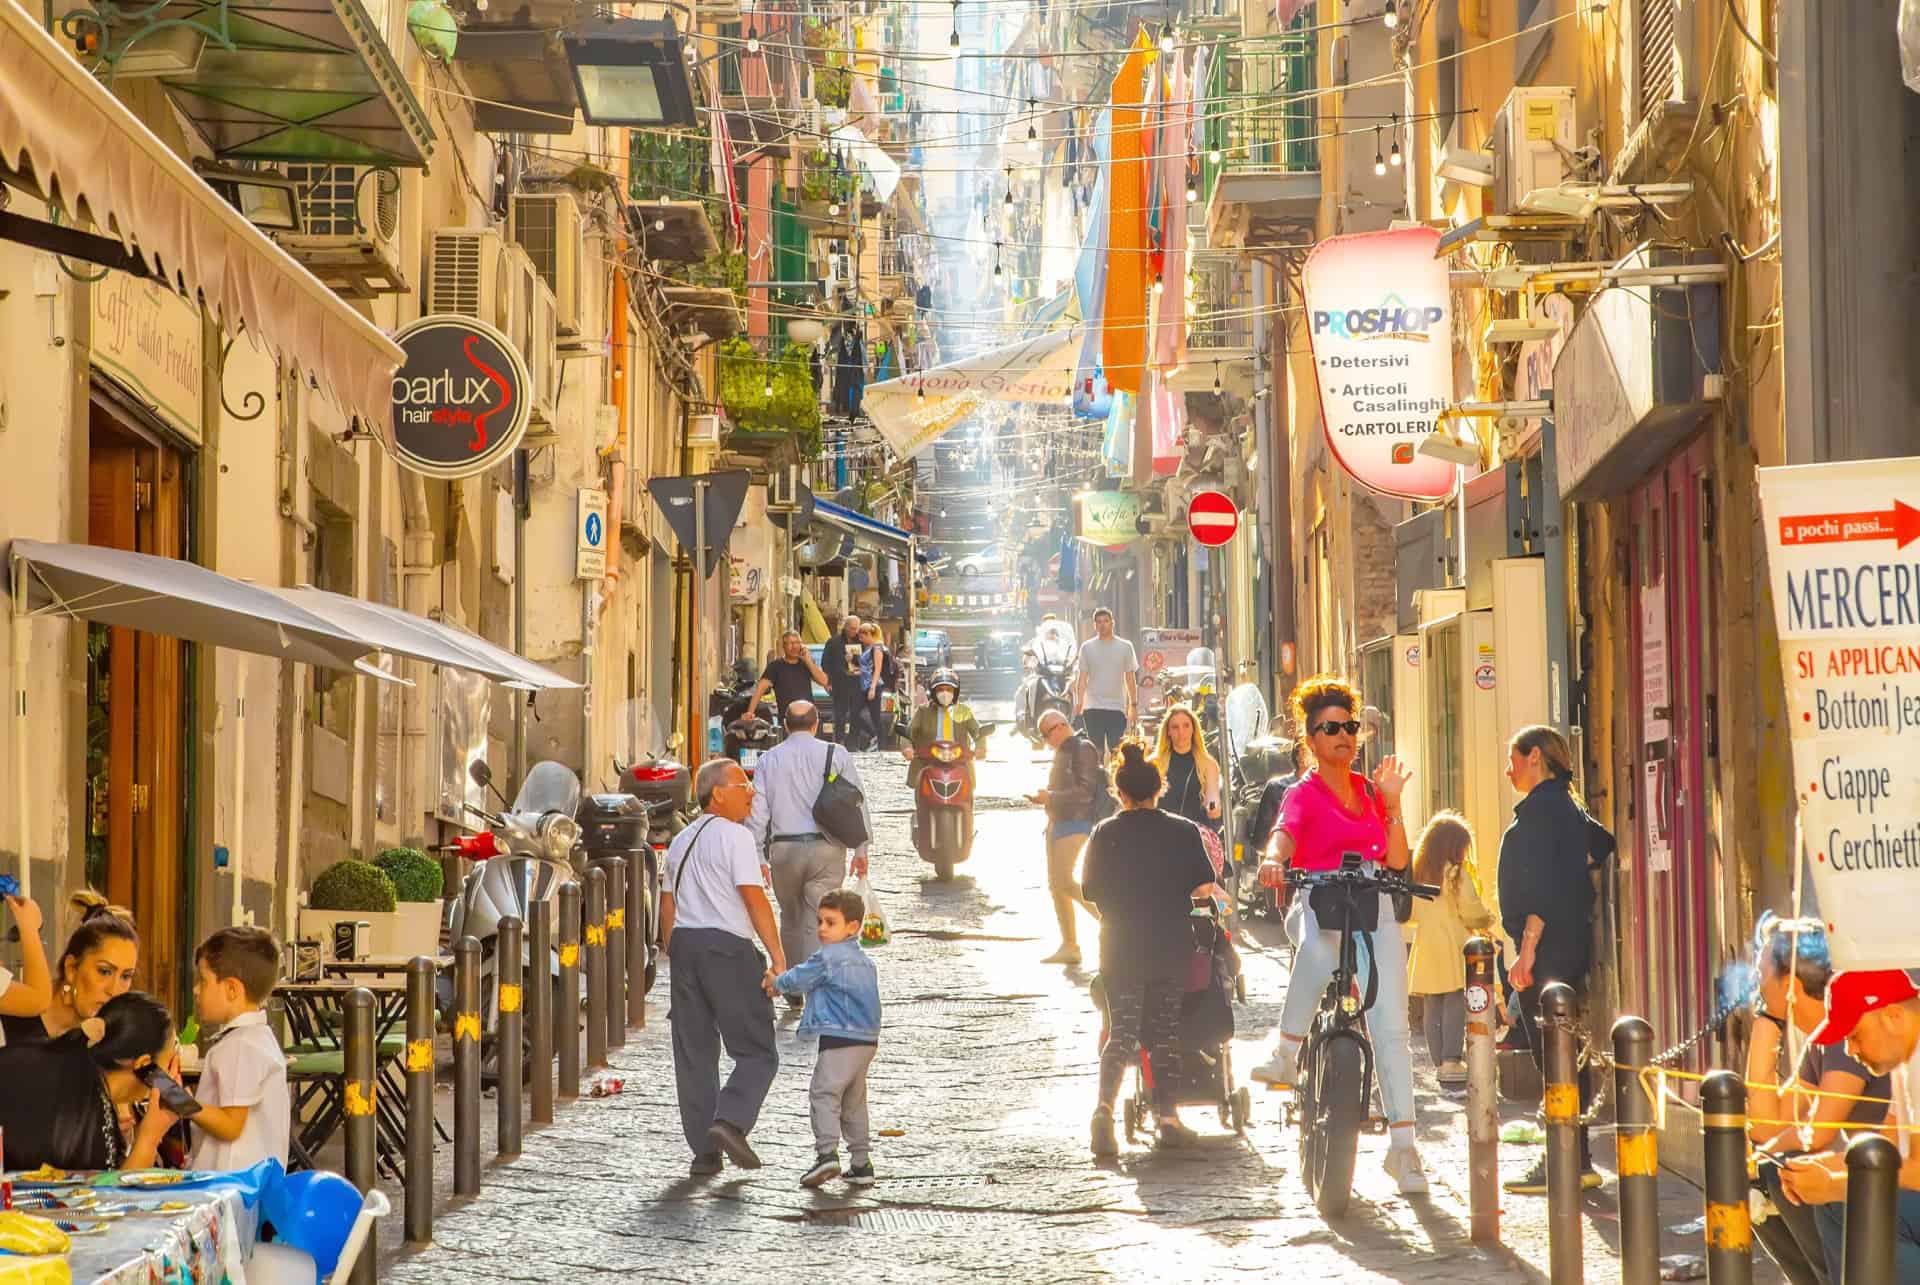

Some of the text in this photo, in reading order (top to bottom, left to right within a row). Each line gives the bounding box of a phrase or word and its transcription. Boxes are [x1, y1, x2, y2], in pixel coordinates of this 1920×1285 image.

[1314, 306, 1443, 340] PROSHOP
[166, 328, 198, 398] Freddo
[1330, 354, 1409, 369] Detersivi
[1342, 382, 1408, 397] Articoli
[1353, 397, 1446, 414] Casalinghi
[1784, 516, 1894, 541] a pochi passi...
[1797, 650, 1814, 679] SI
[1816, 682, 1888, 730] Bottoni
[1822, 755, 1890, 814] Ciappe
